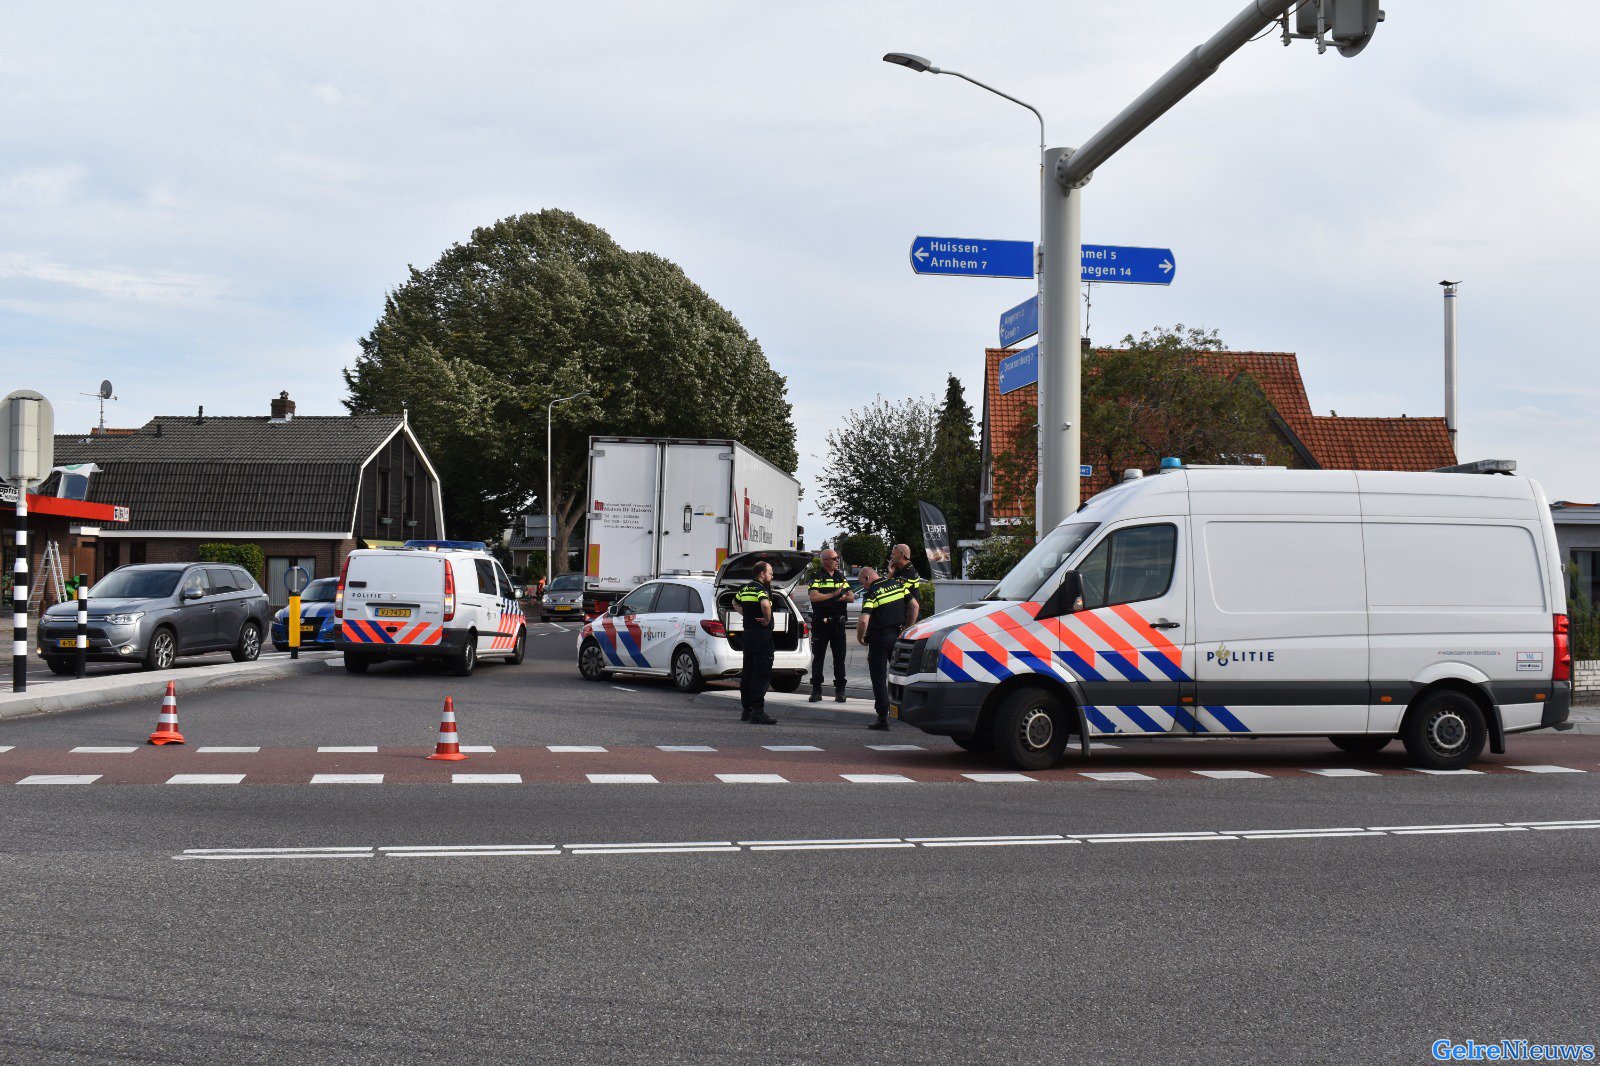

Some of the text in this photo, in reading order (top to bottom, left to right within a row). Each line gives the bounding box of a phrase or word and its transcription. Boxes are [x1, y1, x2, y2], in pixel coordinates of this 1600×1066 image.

[930, 241, 979, 254] Huissen
[1110, 251, 1117, 260] 5
[930, 257, 987, 269] Arnhem 7
[1120, 267, 1131, 276] 14
[643, 631, 667, 641] POLITIE
[1206, 651, 1275, 667] POLITIE
